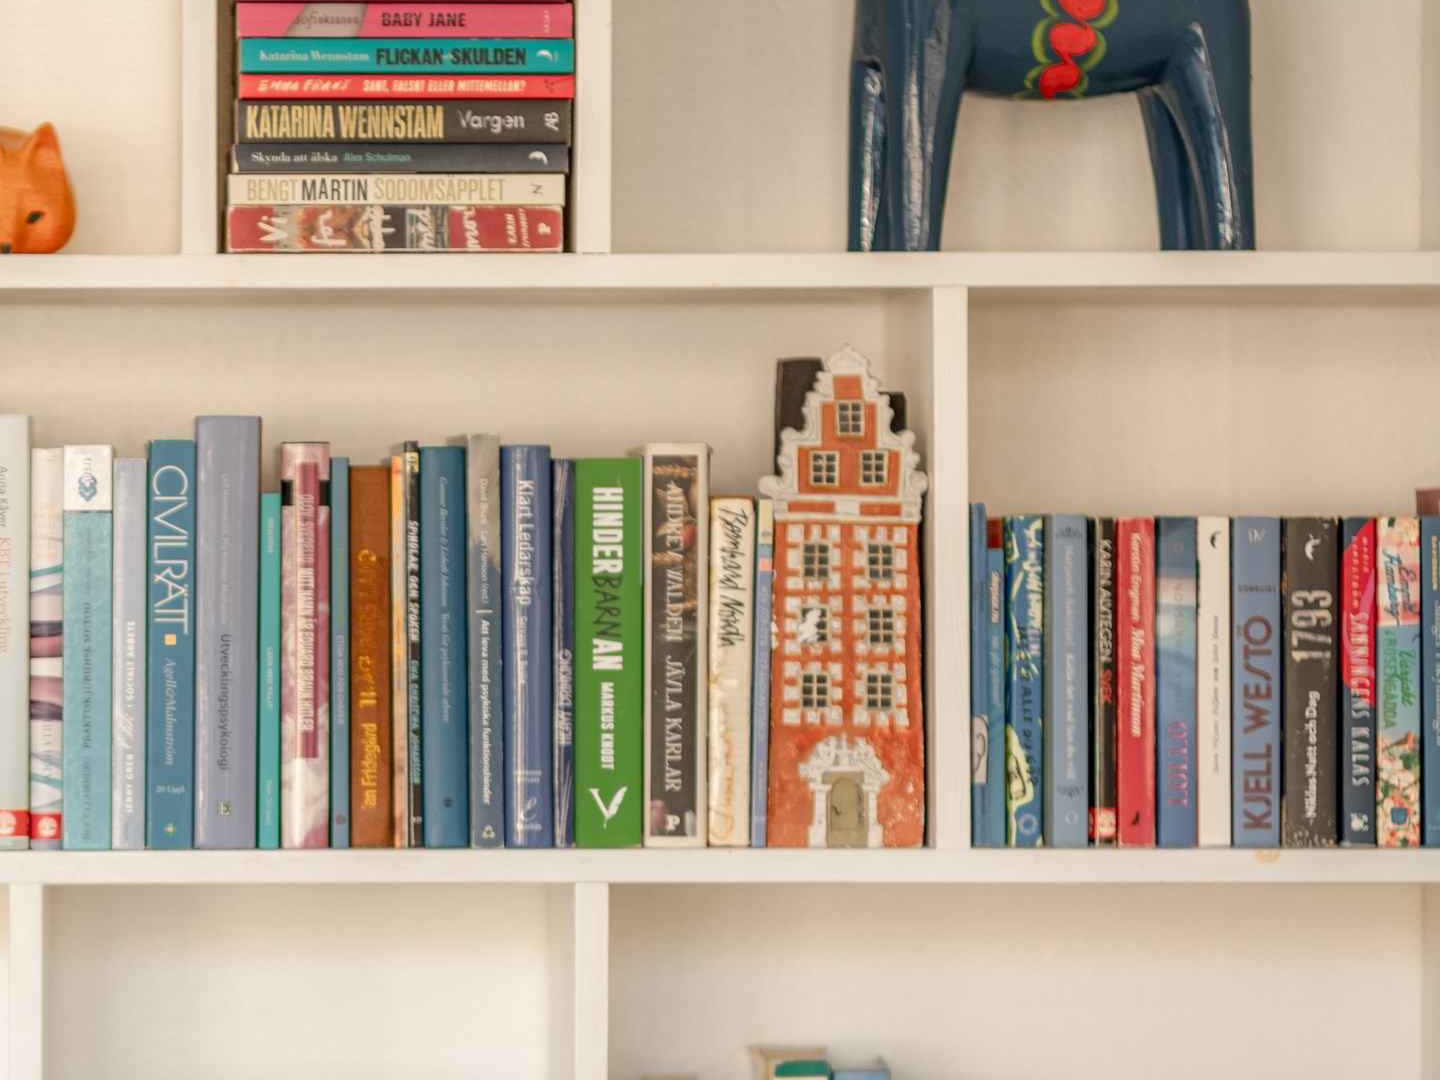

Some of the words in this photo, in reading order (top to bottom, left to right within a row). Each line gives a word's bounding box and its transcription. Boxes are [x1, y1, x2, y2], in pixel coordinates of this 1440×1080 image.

[382, 12, 420, 27] BABY
[428, 12, 467, 27] JANE
[376, 48, 443, 65] FLICKAN
[451, 48, 527, 65] SKULDEN
[428, 80, 455, 92] ELLER
[247, 105, 335, 138] KATARINA
[339, 105, 444, 138] WENNSTAM
[457, 110, 525, 134] Vargen
[252, 152, 291, 164] Skynda
[293, 152, 308, 163] att
[311, 151, 338, 163] älska
[343, 152, 362, 162] Alex
[247, 179, 299, 201] BENGT
[302, 178, 368, 201] MARTIN
[374, 175, 506, 201] SODOMSÄPPLET
[258, 216, 288, 242] Vi
[518, 480, 535, 519] Klart
[665, 483, 684, 558] ANDREV
[153, 465, 188, 636] CIVILRÄTT
[516, 523, 535, 605] Ledarskap
[1099, 539, 1111, 588] KARIN
[665, 567, 683, 642] WALDEN
[1291, 589, 1333, 662] 1793
[480, 619, 491, 636] Att
[481, 638, 492, 657] leva
[481, 659, 492, 681] med
[665, 655, 686, 711] JÄVLA
[1100, 670, 1111, 705] SVEK
[1237, 616, 1272, 734] WESTÖ
[216, 634, 233, 771] Utvecklingspsykologi
[479, 684, 492, 726] psykiska
[601, 682, 614, 730] MARKUS
[1306, 690, 1320, 718] Dag
[1306, 719, 1317, 744] och
[481, 727, 492, 804] funktionshinder
[665, 717, 682, 792] KARLAR
[1167, 721, 1189, 806] LOLLO
[1306, 745, 1317, 776] Natt
[1352, 727, 1370, 786] KALAS
[1243, 744, 1272, 830] KJELL
